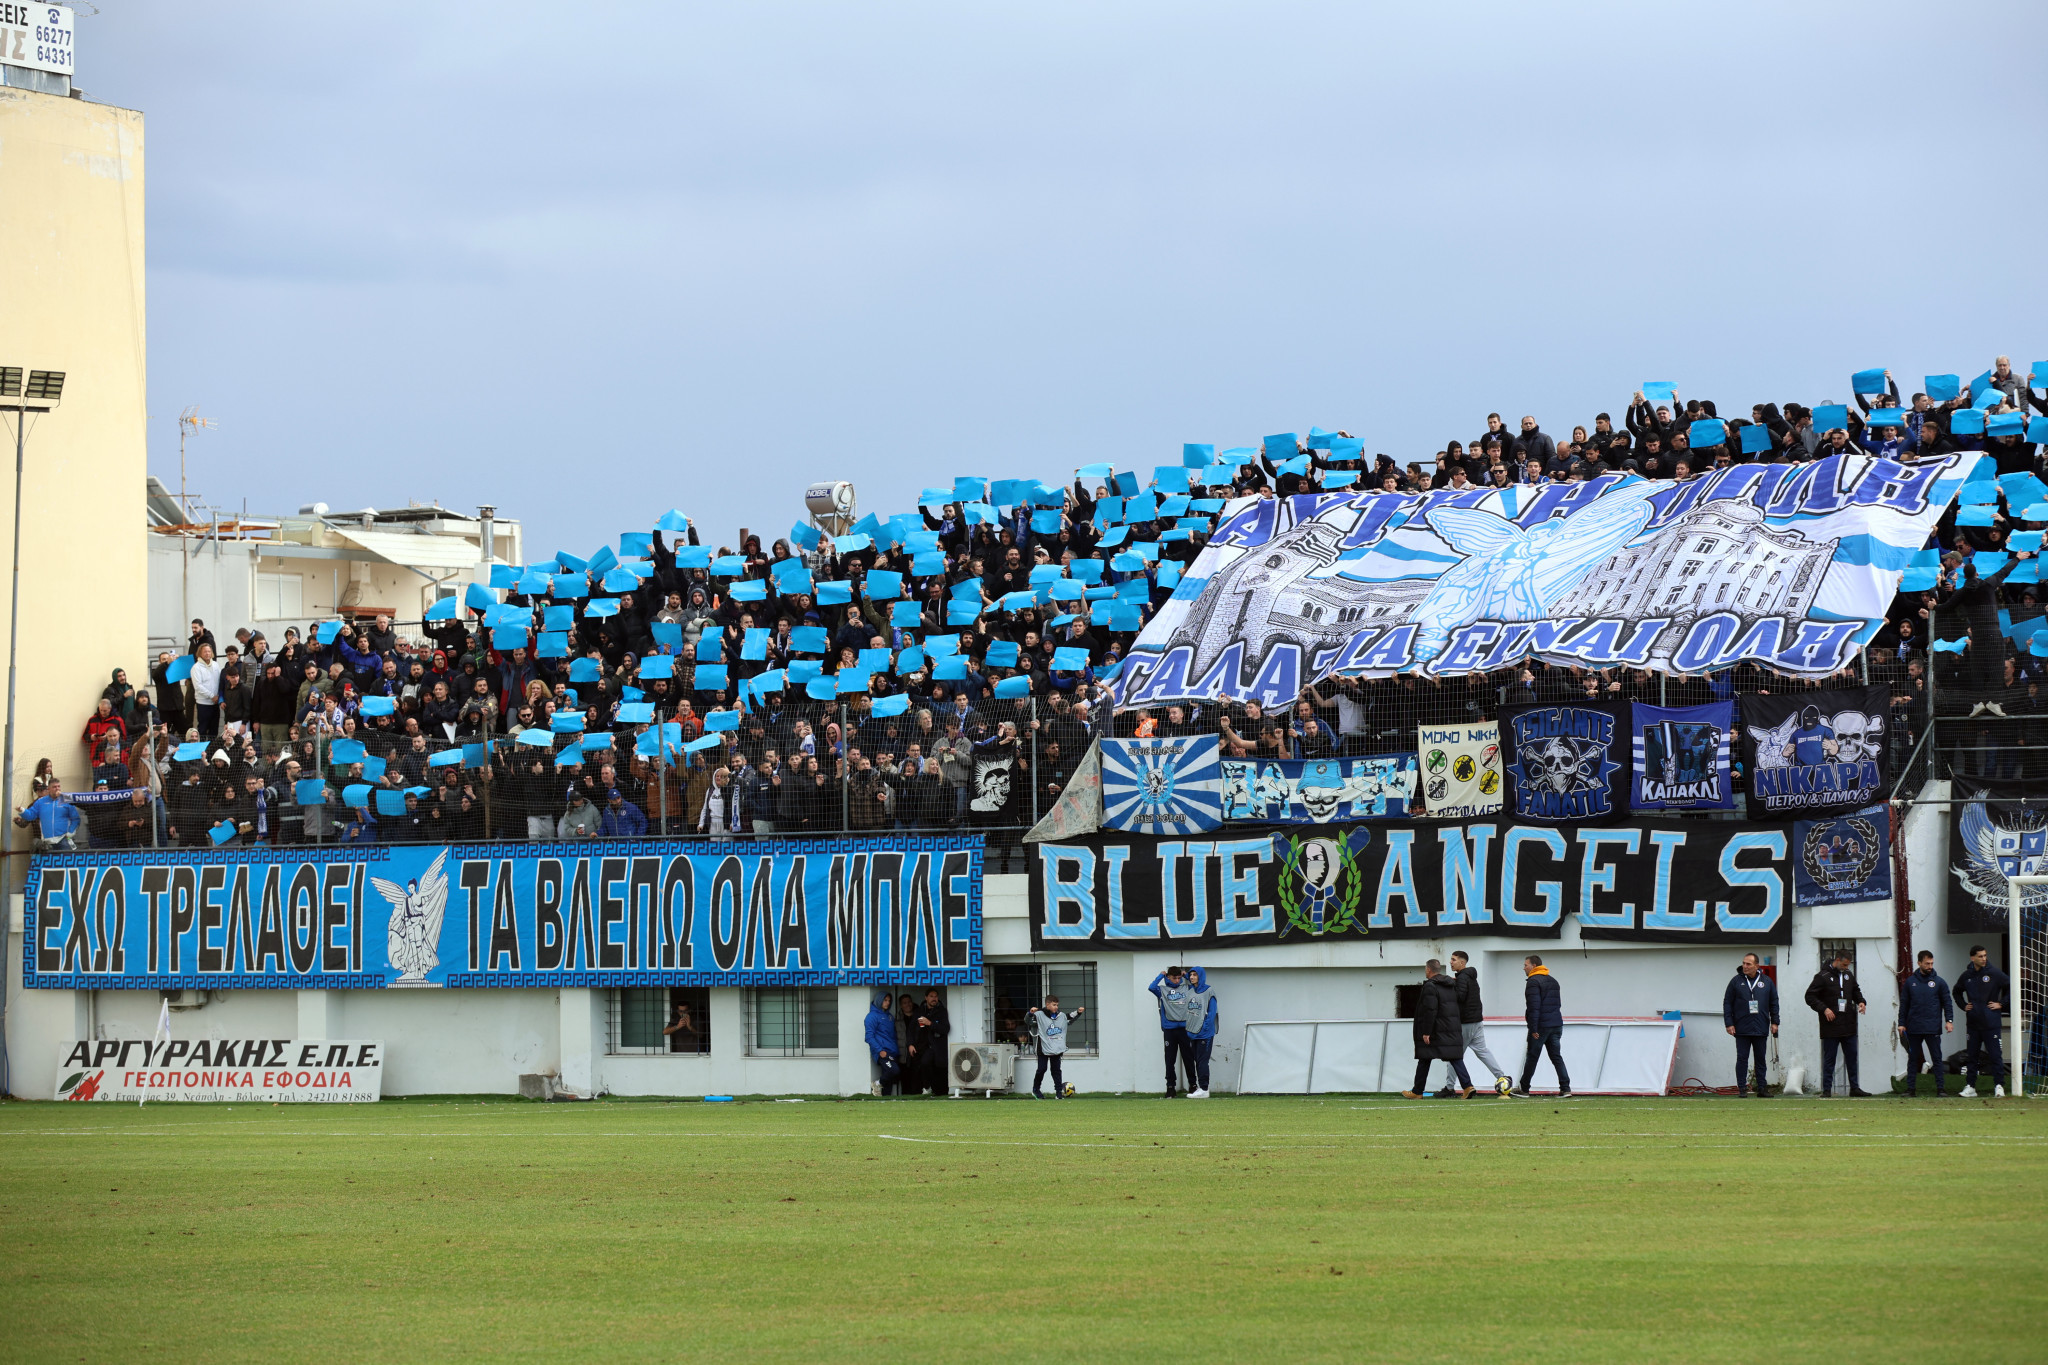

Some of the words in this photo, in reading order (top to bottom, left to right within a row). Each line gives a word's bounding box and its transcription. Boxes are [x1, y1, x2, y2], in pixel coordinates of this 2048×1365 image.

[36, 25, 71, 46] 66277
[37, 45, 72, 66] 64331
[806, 489, 830, 498] NOBEL
[1431, 617, 1666, 674] ΕΙΝΑΙ
[1673, 614, 1865, 671] ΟΛΗ
[1422, 730, 1460, 744] ΜΟΝΟ
[1467, 729, 1498, 741] ΝΙΚΗ
[1511, 707, 1615, 746] TSIGANTE
[75, 794, 99, 802] ΝΙΚΗ
[1516, 786, 1611, 819] FANATIC
[1767, 794, 1808, 807] ΠΕΤΡΟΥ
[1038, 837, 1276, 939] BLUE
[1367, 824, 1788, 933] ANGELS
[36, 866, 125, 974] ΕΧΩ
[140, 863, 367, 974] ΤΡΕΛΑΘΕΙ
[460, 858, 522, 971] ΤΑ
[535, 854, 694, 970] ΒΛΕΠΩ
[709, 854, 812, 971] ΟΛΑ
[827, 852, 970, 969] ΜΠΛΕ
[63, 1040, 291, 1067] ΑΡΓΥΡΑΚΗΣ
[297, 1044, 380, 1067] Ε.Π.Ε.
[123, 1071, 255, 1088] ΓΕΩΠΟΝΙΚΑ
[263, 1070, 353, 1088] ΕΦΟΔΙΑ
[307, 1092, 338, 1101] 24210
[341, 1092, 373, 1101] 81888
